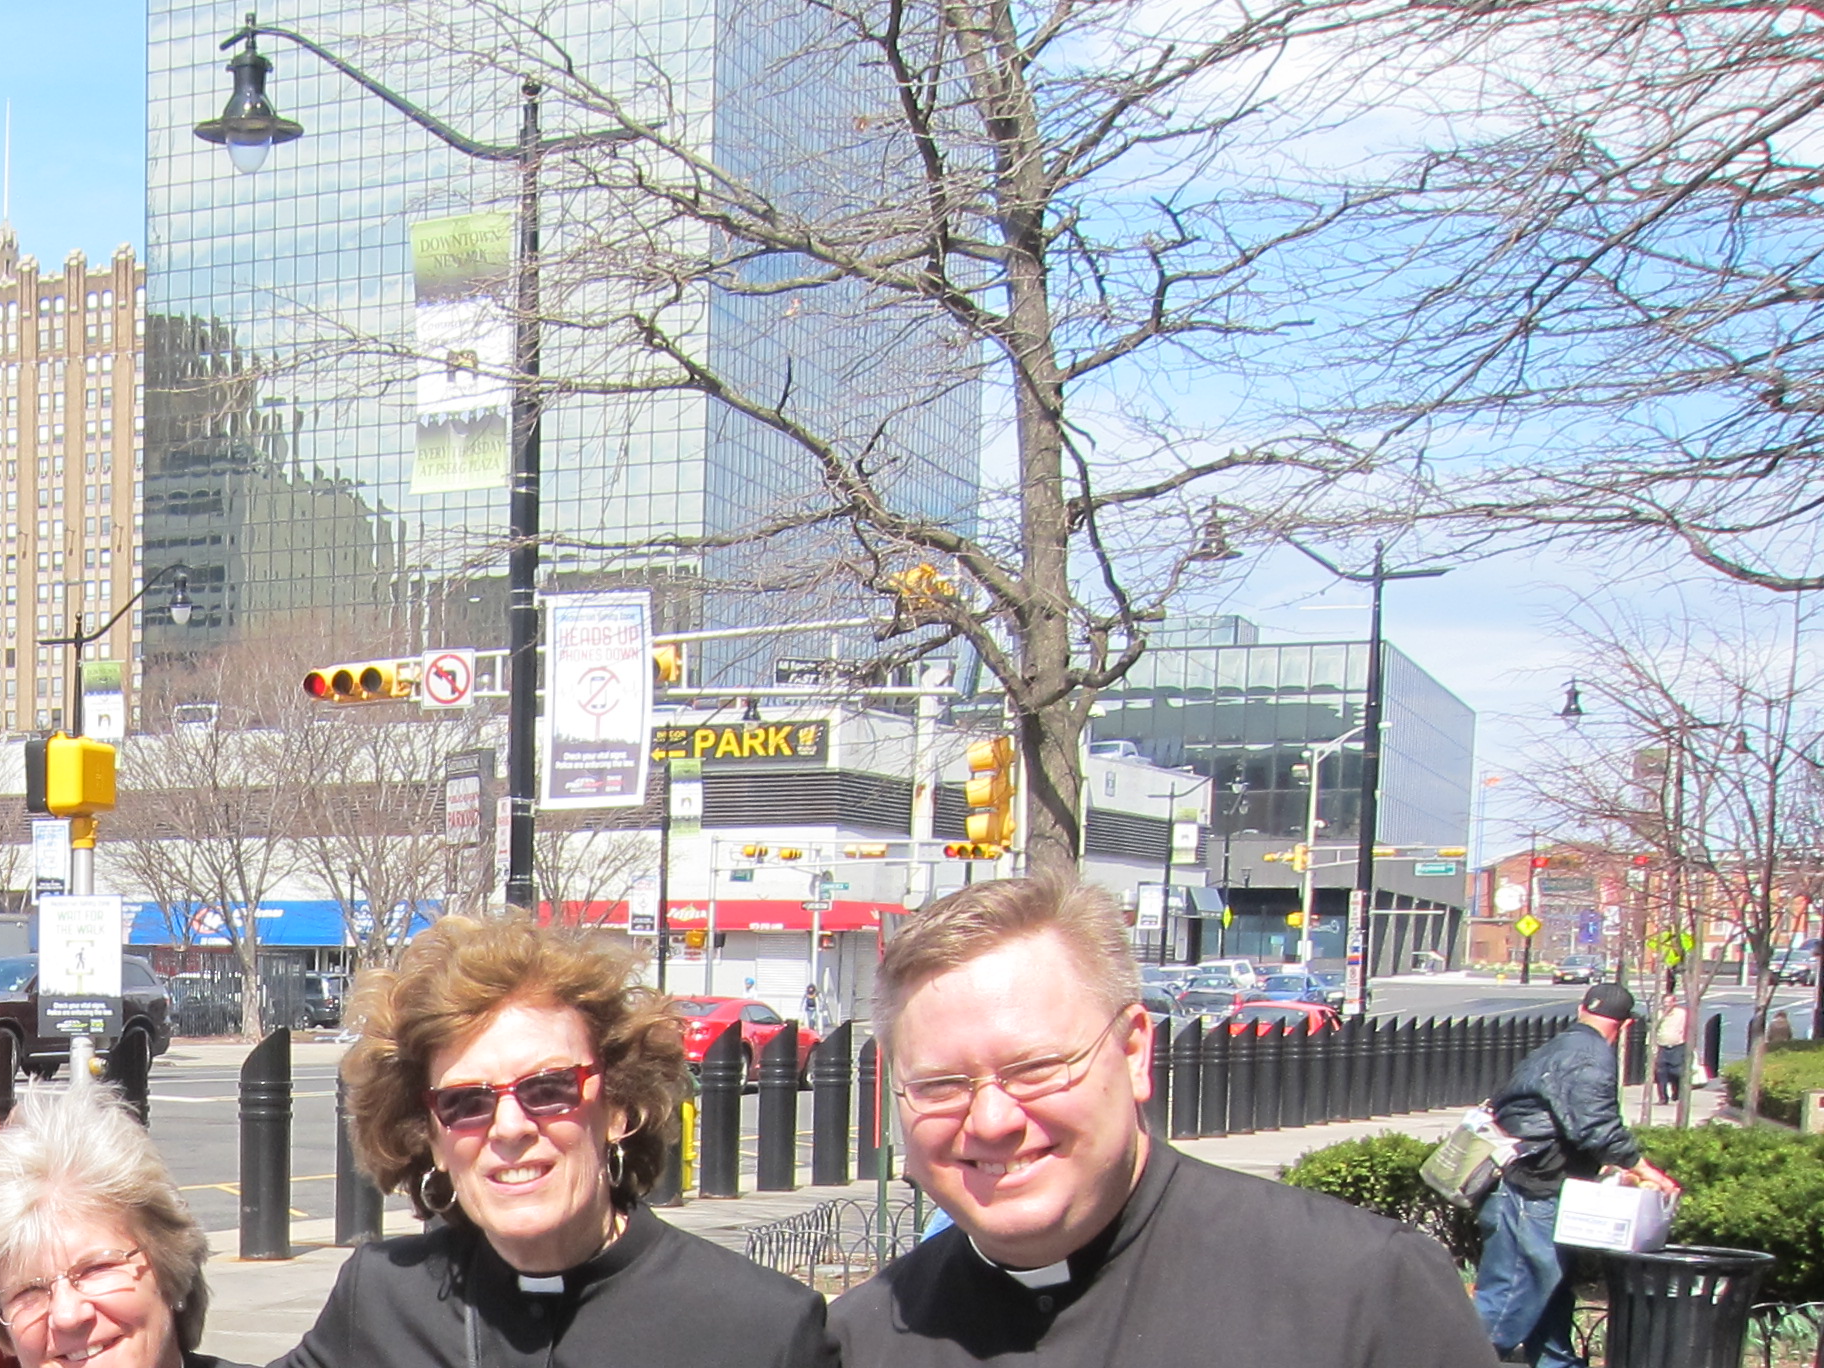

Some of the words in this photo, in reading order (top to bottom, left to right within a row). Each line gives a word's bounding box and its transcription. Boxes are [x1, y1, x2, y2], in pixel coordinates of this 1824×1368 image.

[420, 230, 500, 253] DOWNTOWN
[418, 446, 446, 461] EVERY
[452, 440, 502, 458] THURSDAY
[419, 463, 433, 478] AT
[469, 458, 500, 473] PLAZA
[559, 627, 612, 648] HEADS
[618, 625, 640, 645] UP
[560, 648, 603, 662] PHONES
[605, 647, 639, 661] DOWN
[693, 725, 793, 759] PARK
[57, 911, 81, 921] WAIT
[85, 910, 104, 921] FOR
[56, 924, 73, 935] THE
[77, 924, 104, 935] WALK
